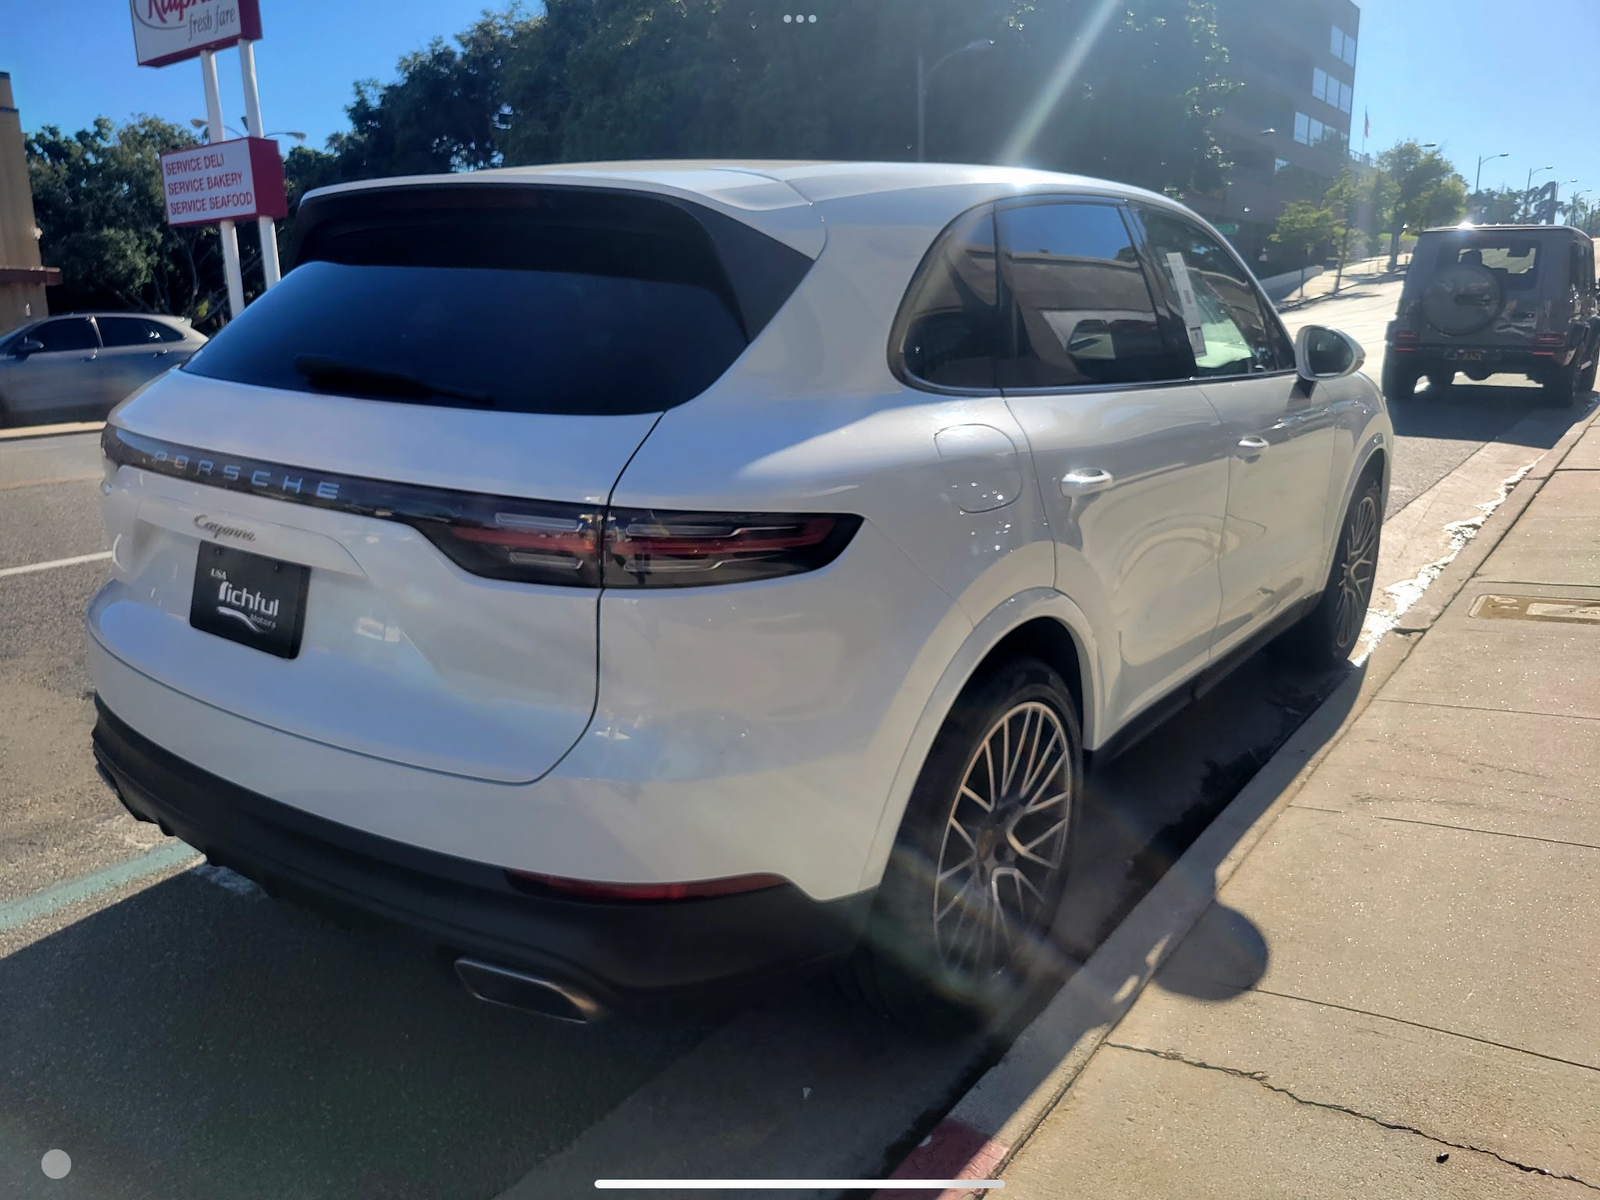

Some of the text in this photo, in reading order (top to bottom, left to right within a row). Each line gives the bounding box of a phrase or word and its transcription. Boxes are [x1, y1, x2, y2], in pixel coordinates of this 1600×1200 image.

[188, 5, 236, 41] fresh fare
[165, 153, 224, 176] SERVICE DELI
[168, 172, 243, 196] SERVICE BAKERY
[170, 192, 253, 216] SERVICE SEAFOOD
[152, 450, 340, 500] PORSCHE
[210, 567, 227, 580] USA
